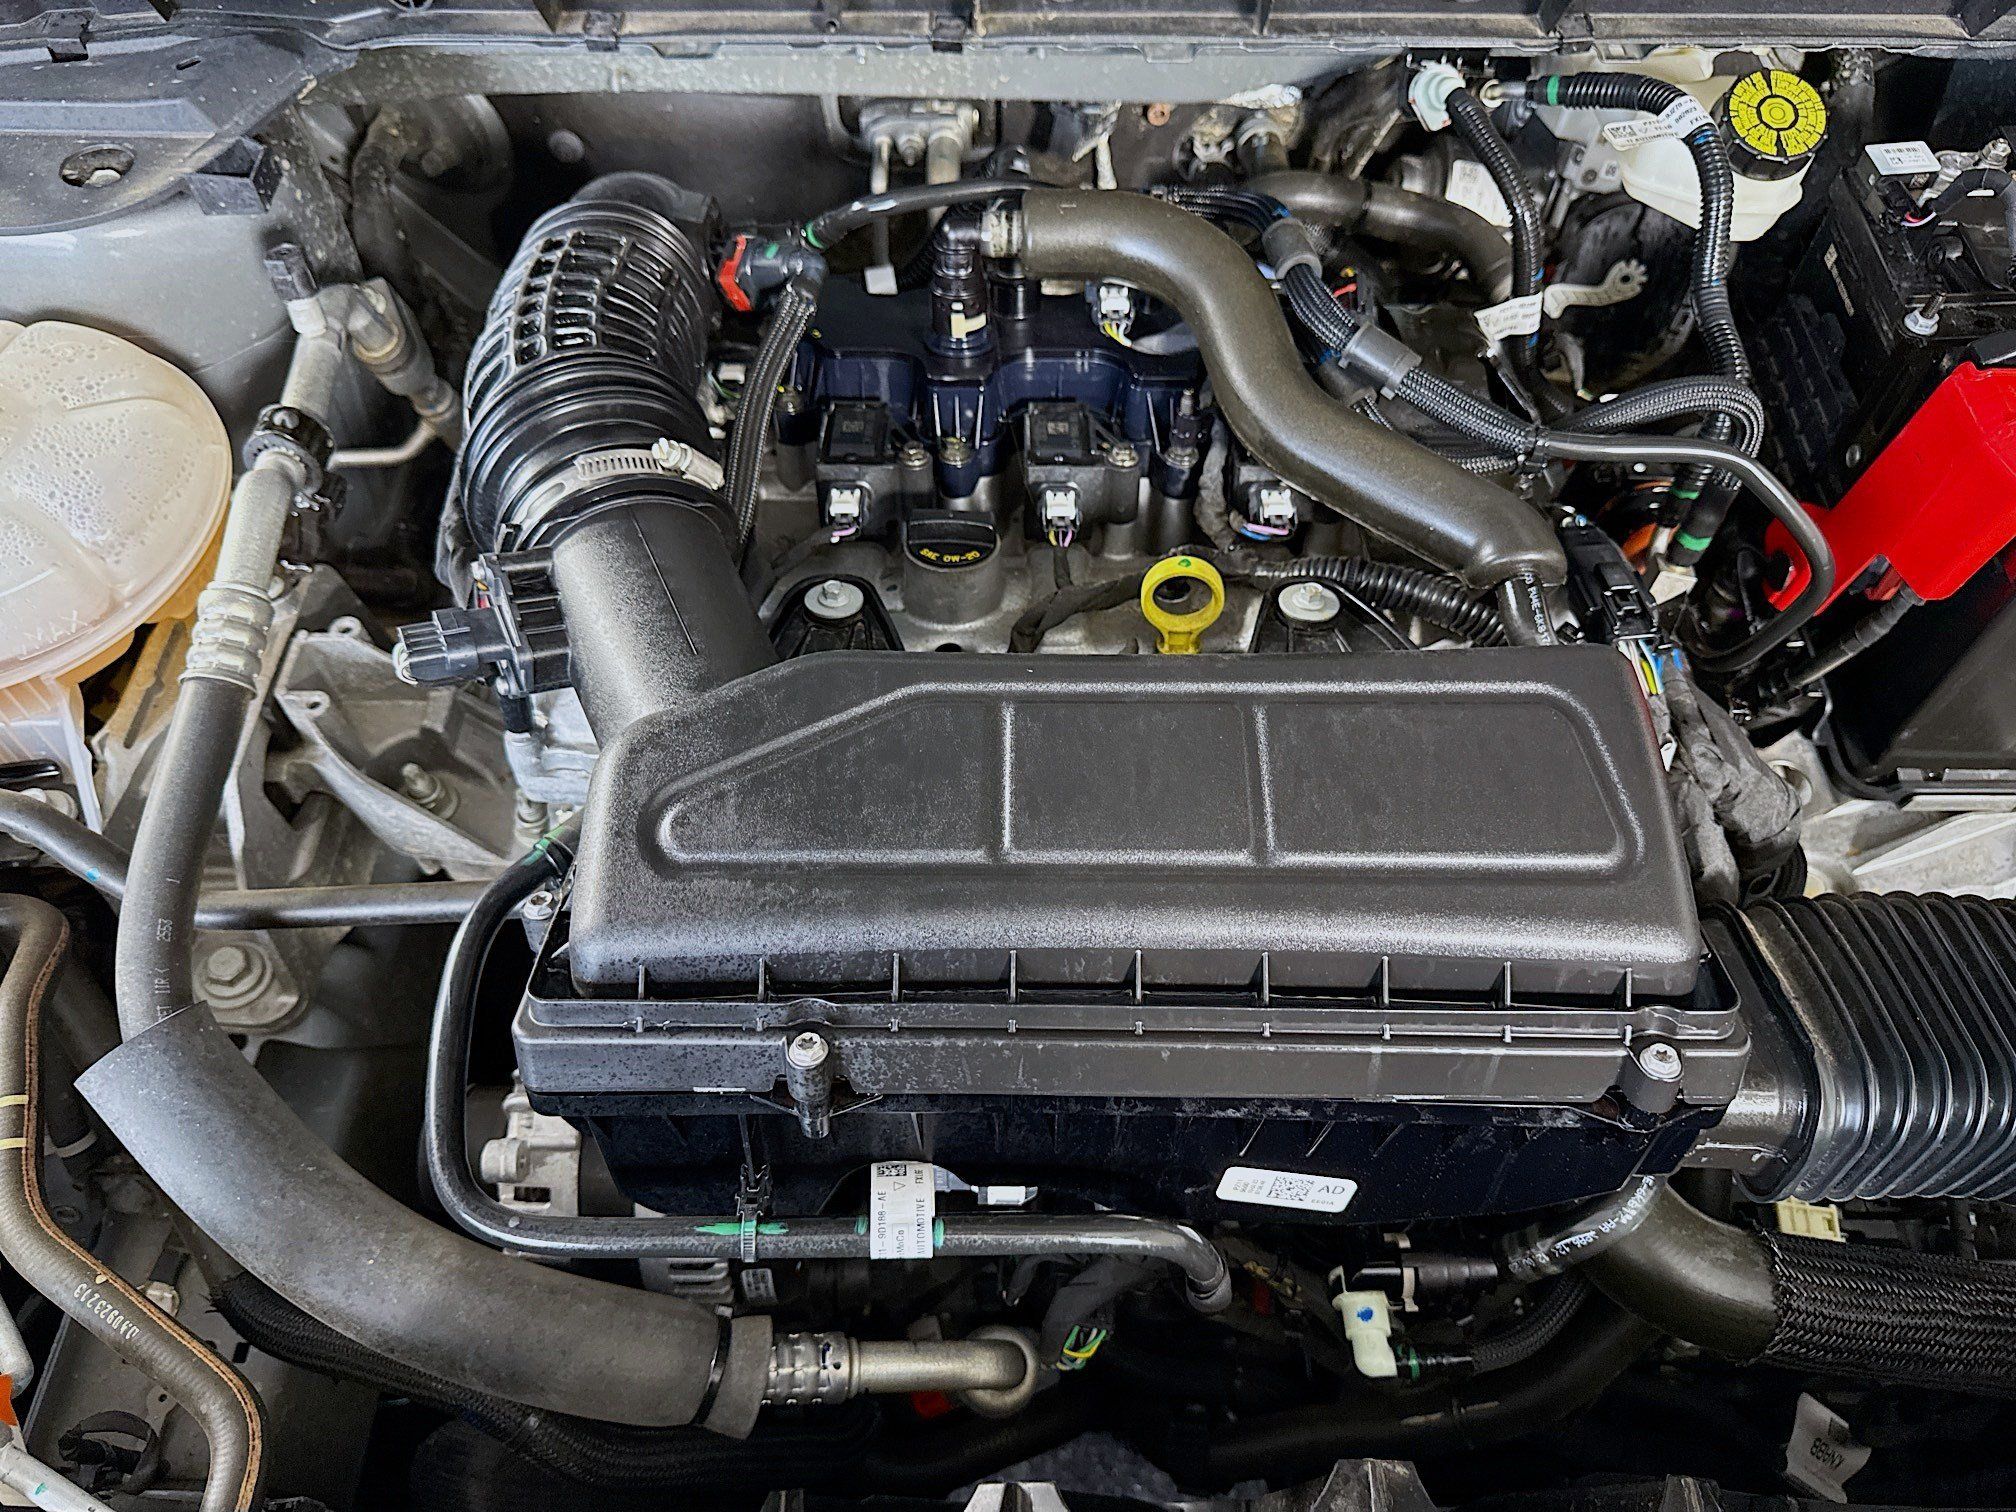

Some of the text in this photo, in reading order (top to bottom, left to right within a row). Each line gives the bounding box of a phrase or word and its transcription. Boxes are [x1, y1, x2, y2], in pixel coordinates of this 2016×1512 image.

[920, 548, 980, 563] SAE 0W-20
[22, 609, 88, 655] MAX
[1317, 1184, 1345, 1195] AD
[916, 1197, 925, 1256] AUTOMOTIVE
